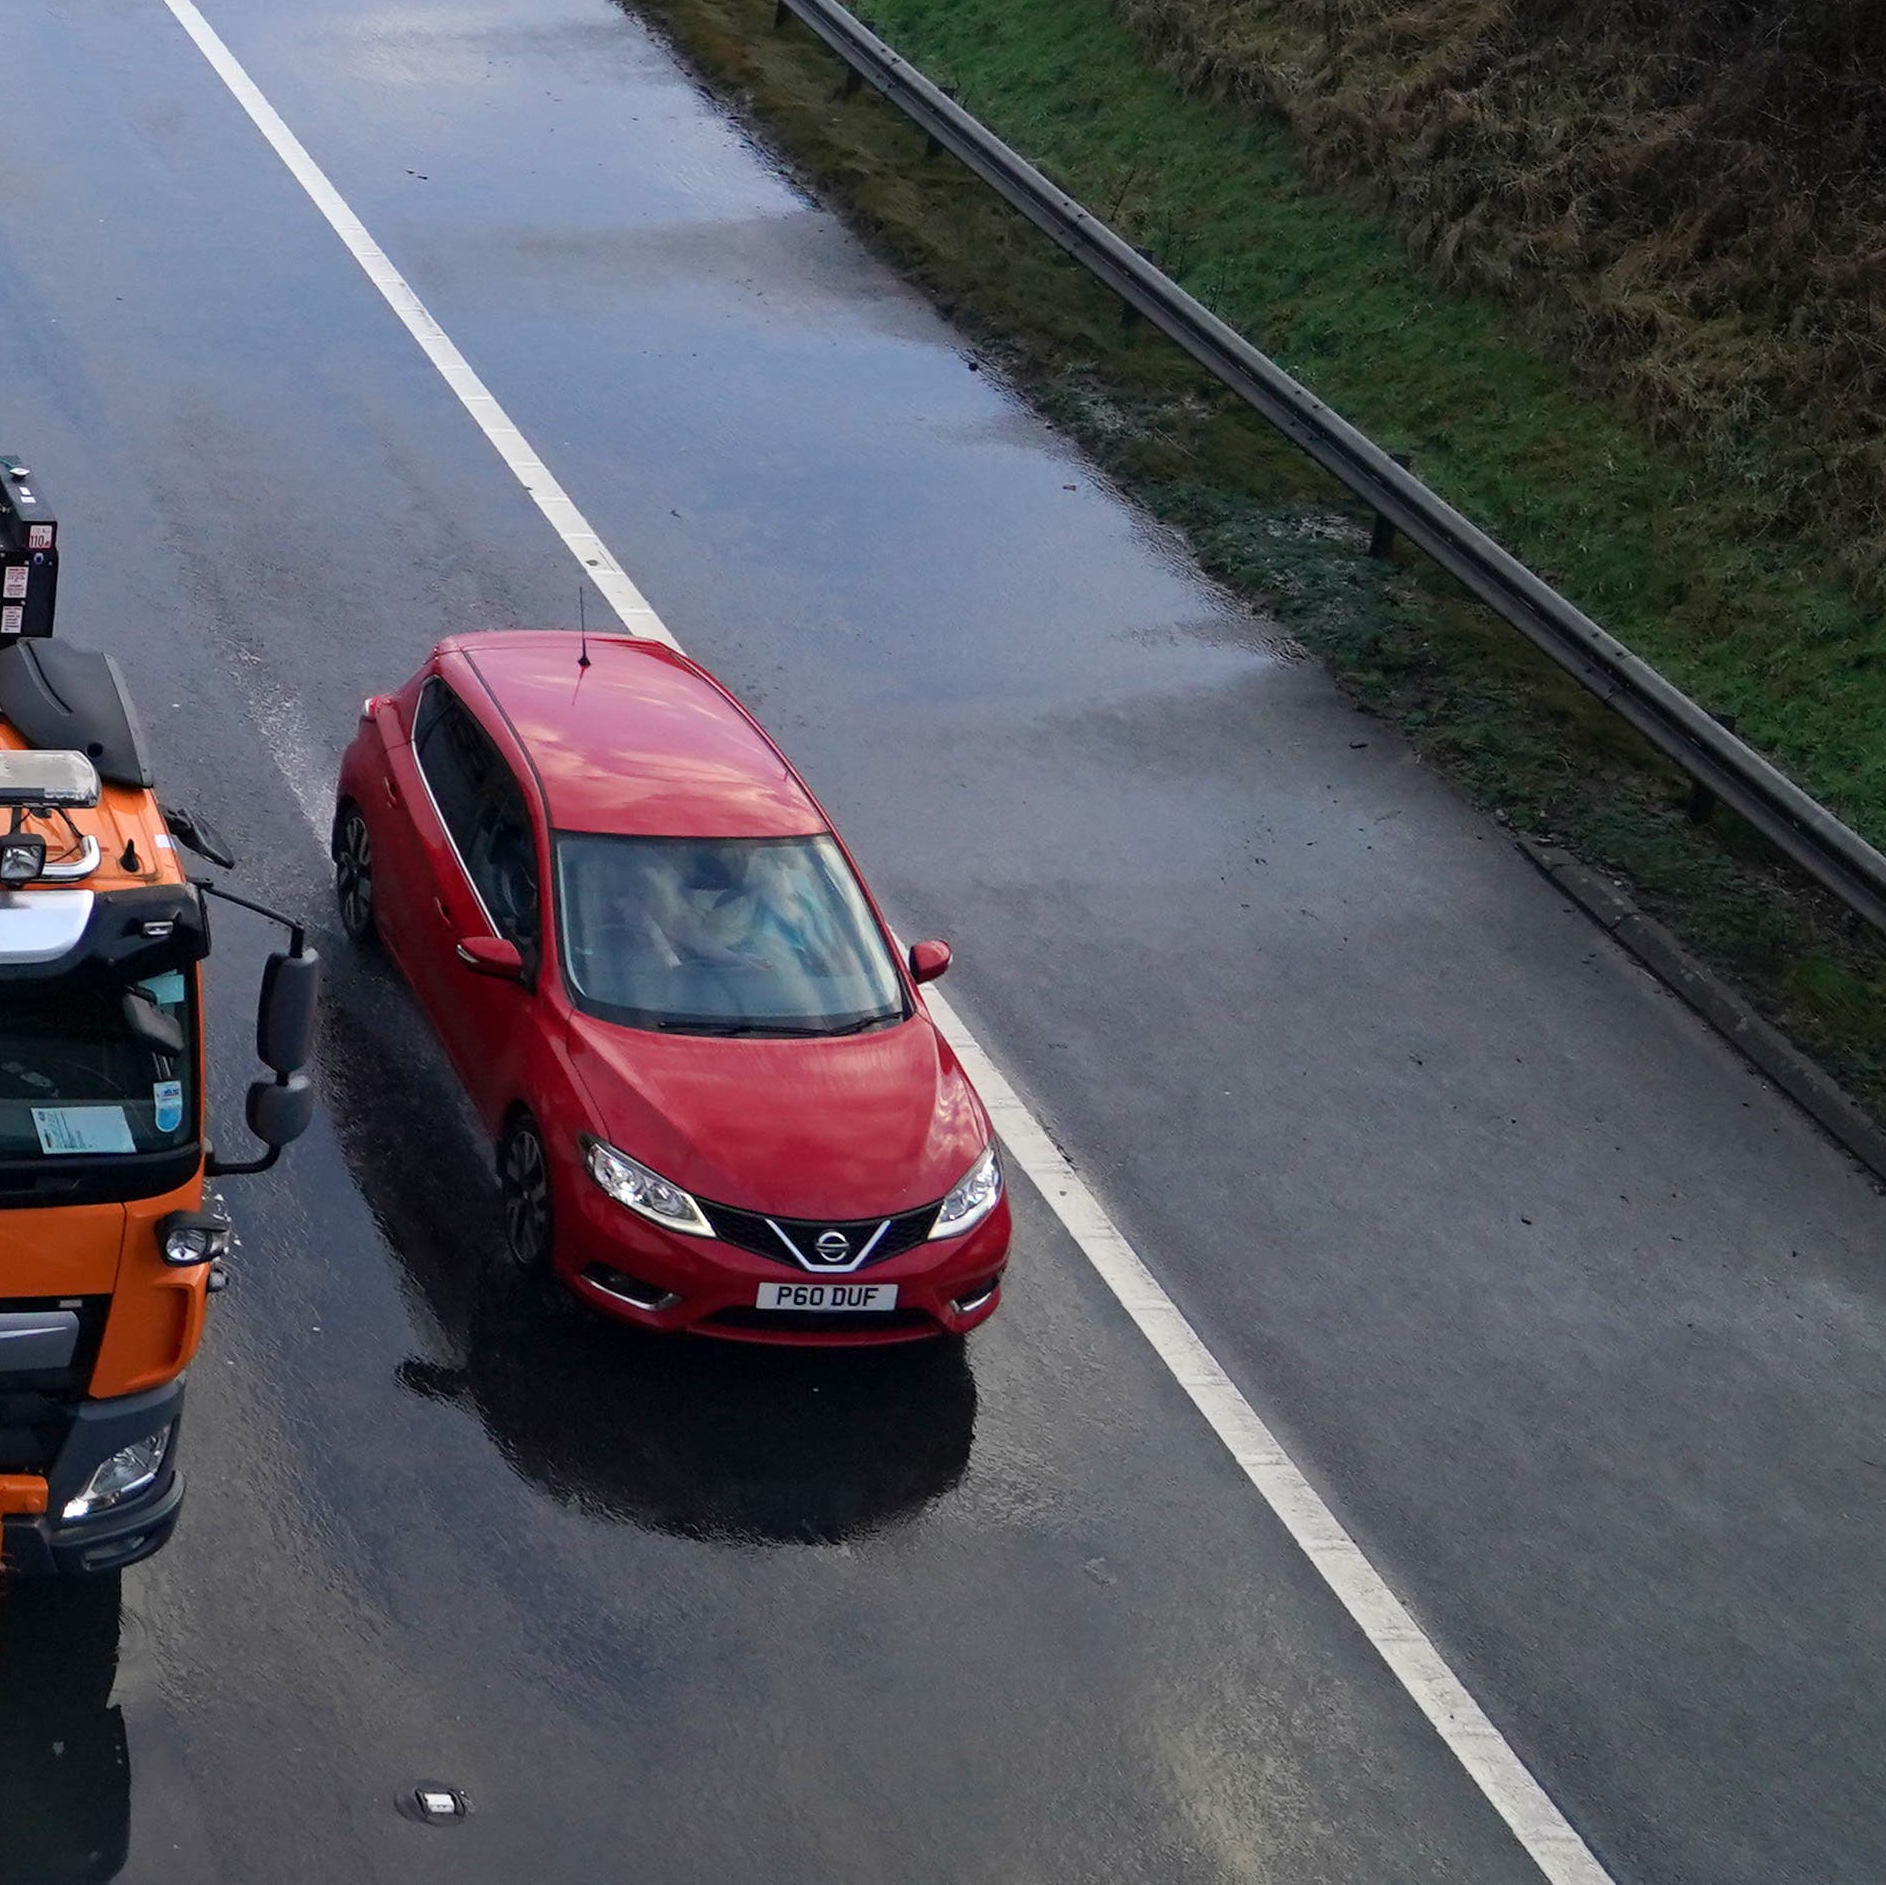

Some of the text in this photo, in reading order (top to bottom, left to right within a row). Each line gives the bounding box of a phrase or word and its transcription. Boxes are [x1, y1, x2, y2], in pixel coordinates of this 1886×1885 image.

[29, 535, 44, 547] 110
[776, 1287, 877, 1307] P60 DUF
